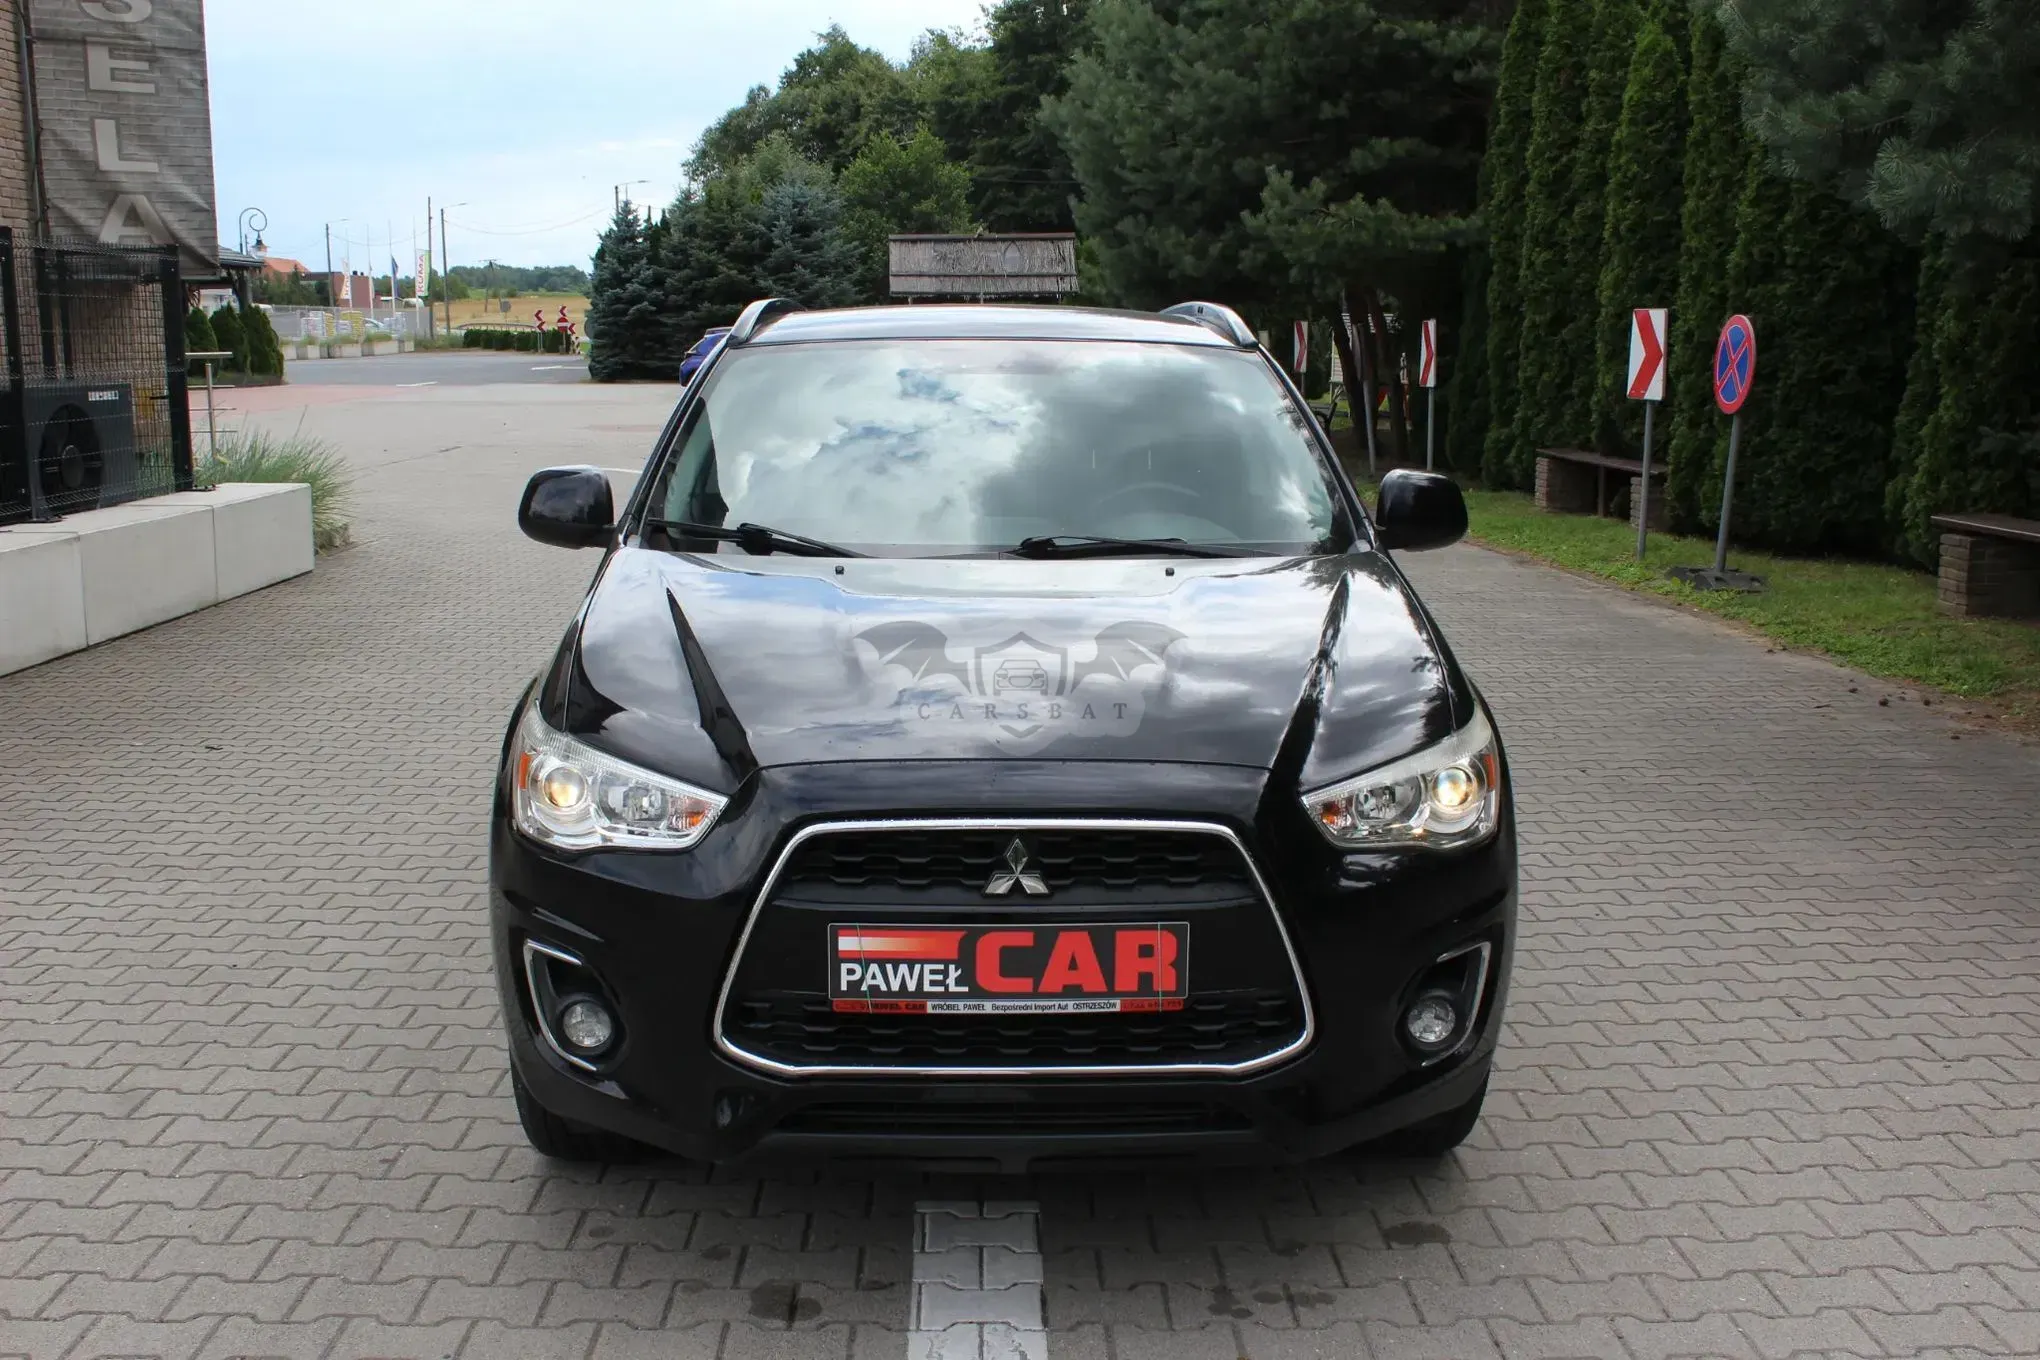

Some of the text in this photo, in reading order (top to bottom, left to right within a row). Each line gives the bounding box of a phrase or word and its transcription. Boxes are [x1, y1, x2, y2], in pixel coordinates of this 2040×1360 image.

[840, 930, 1177, 993] PAWEŁ CAR
[931, 1003, 960, 1011] WRÓBEL
[991, 1003, 1032, 1012] Bezpośredni
[1034, 1003, 1056, 1012] Import
[1072, 1001, 1117, 1010] OSTRZESZÓW
